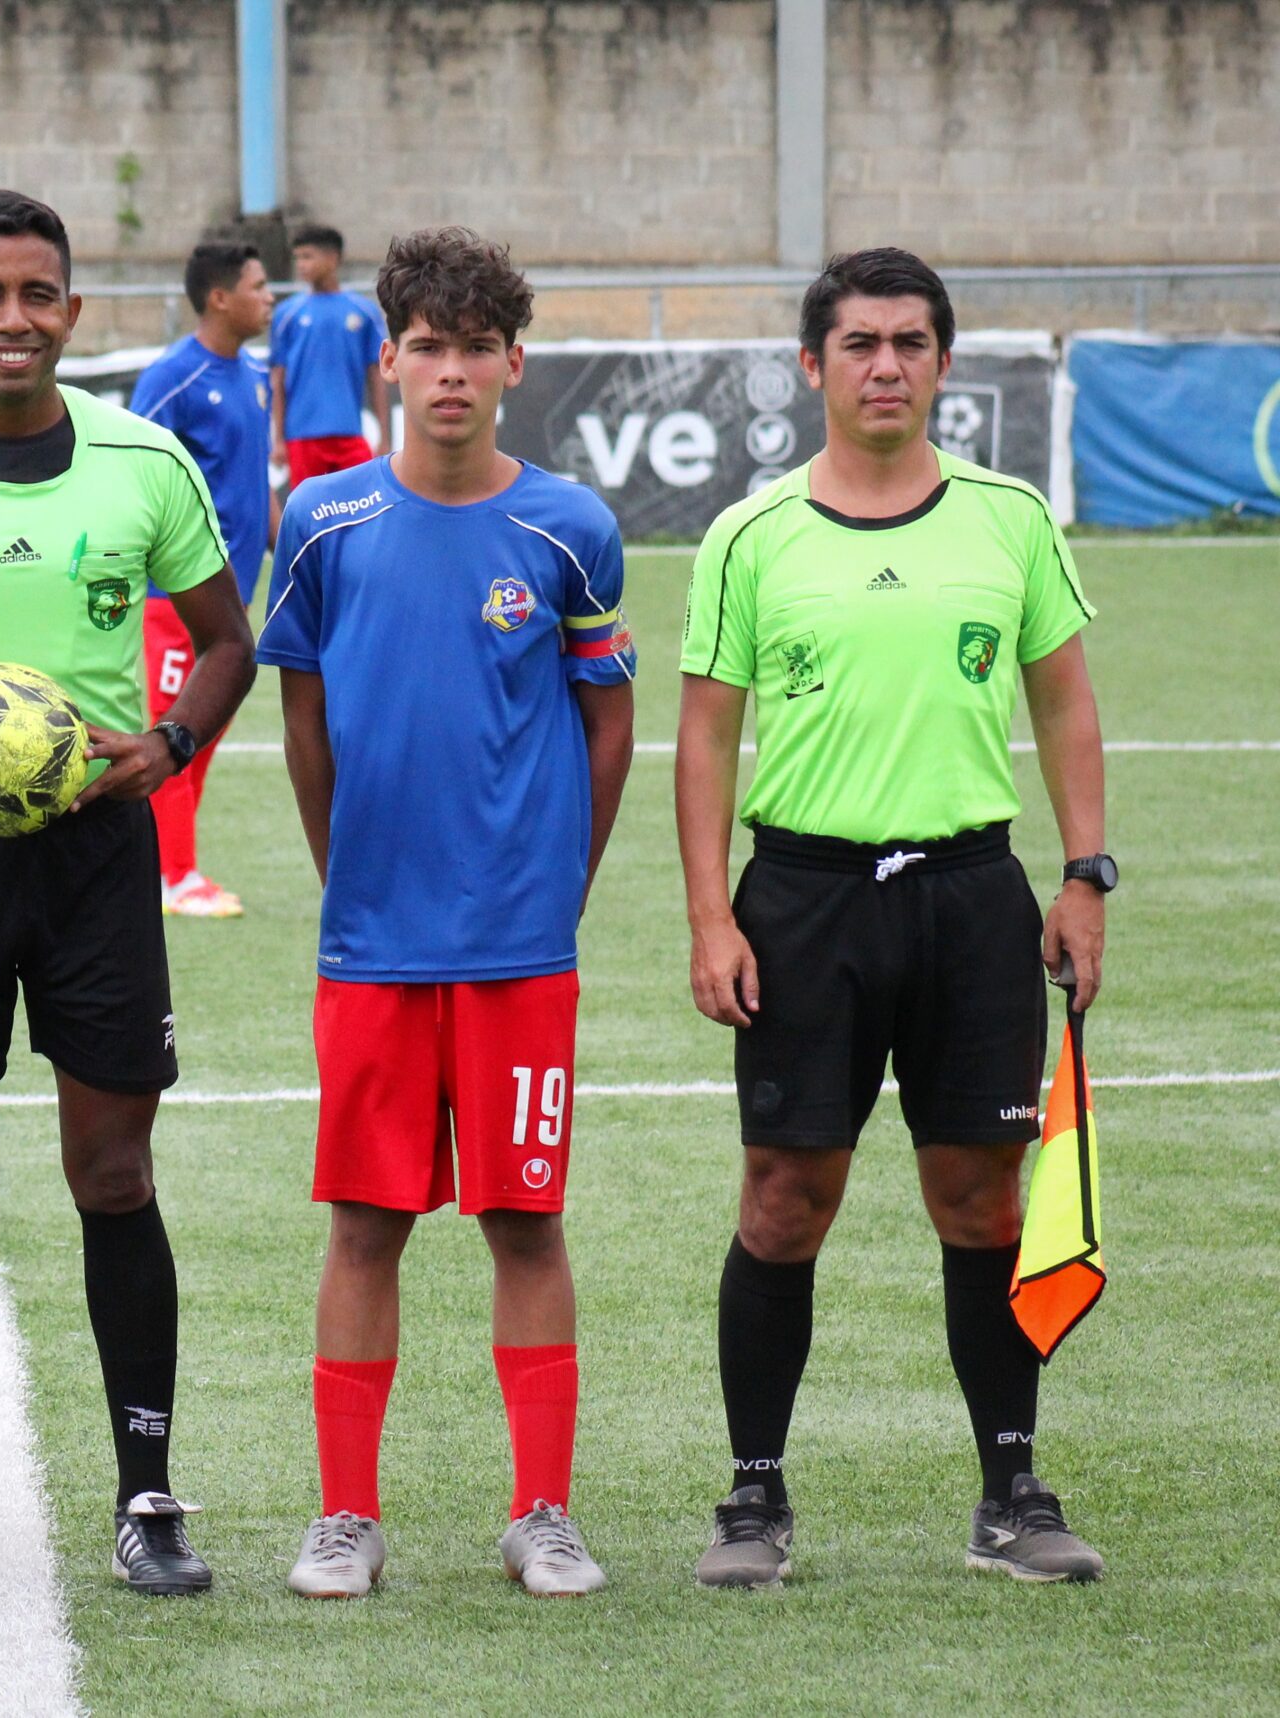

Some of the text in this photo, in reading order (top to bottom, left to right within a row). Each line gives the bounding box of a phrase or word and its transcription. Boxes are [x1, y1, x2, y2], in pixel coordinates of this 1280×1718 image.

[311, 490, 383, 520] uhlsport
[866, 580, 907, 591] adidas
[160, 648, 187, 695] 6
[512, 1066, 566, 1146] 19
[1000, 1105, 1037, 1121] uhlsp
